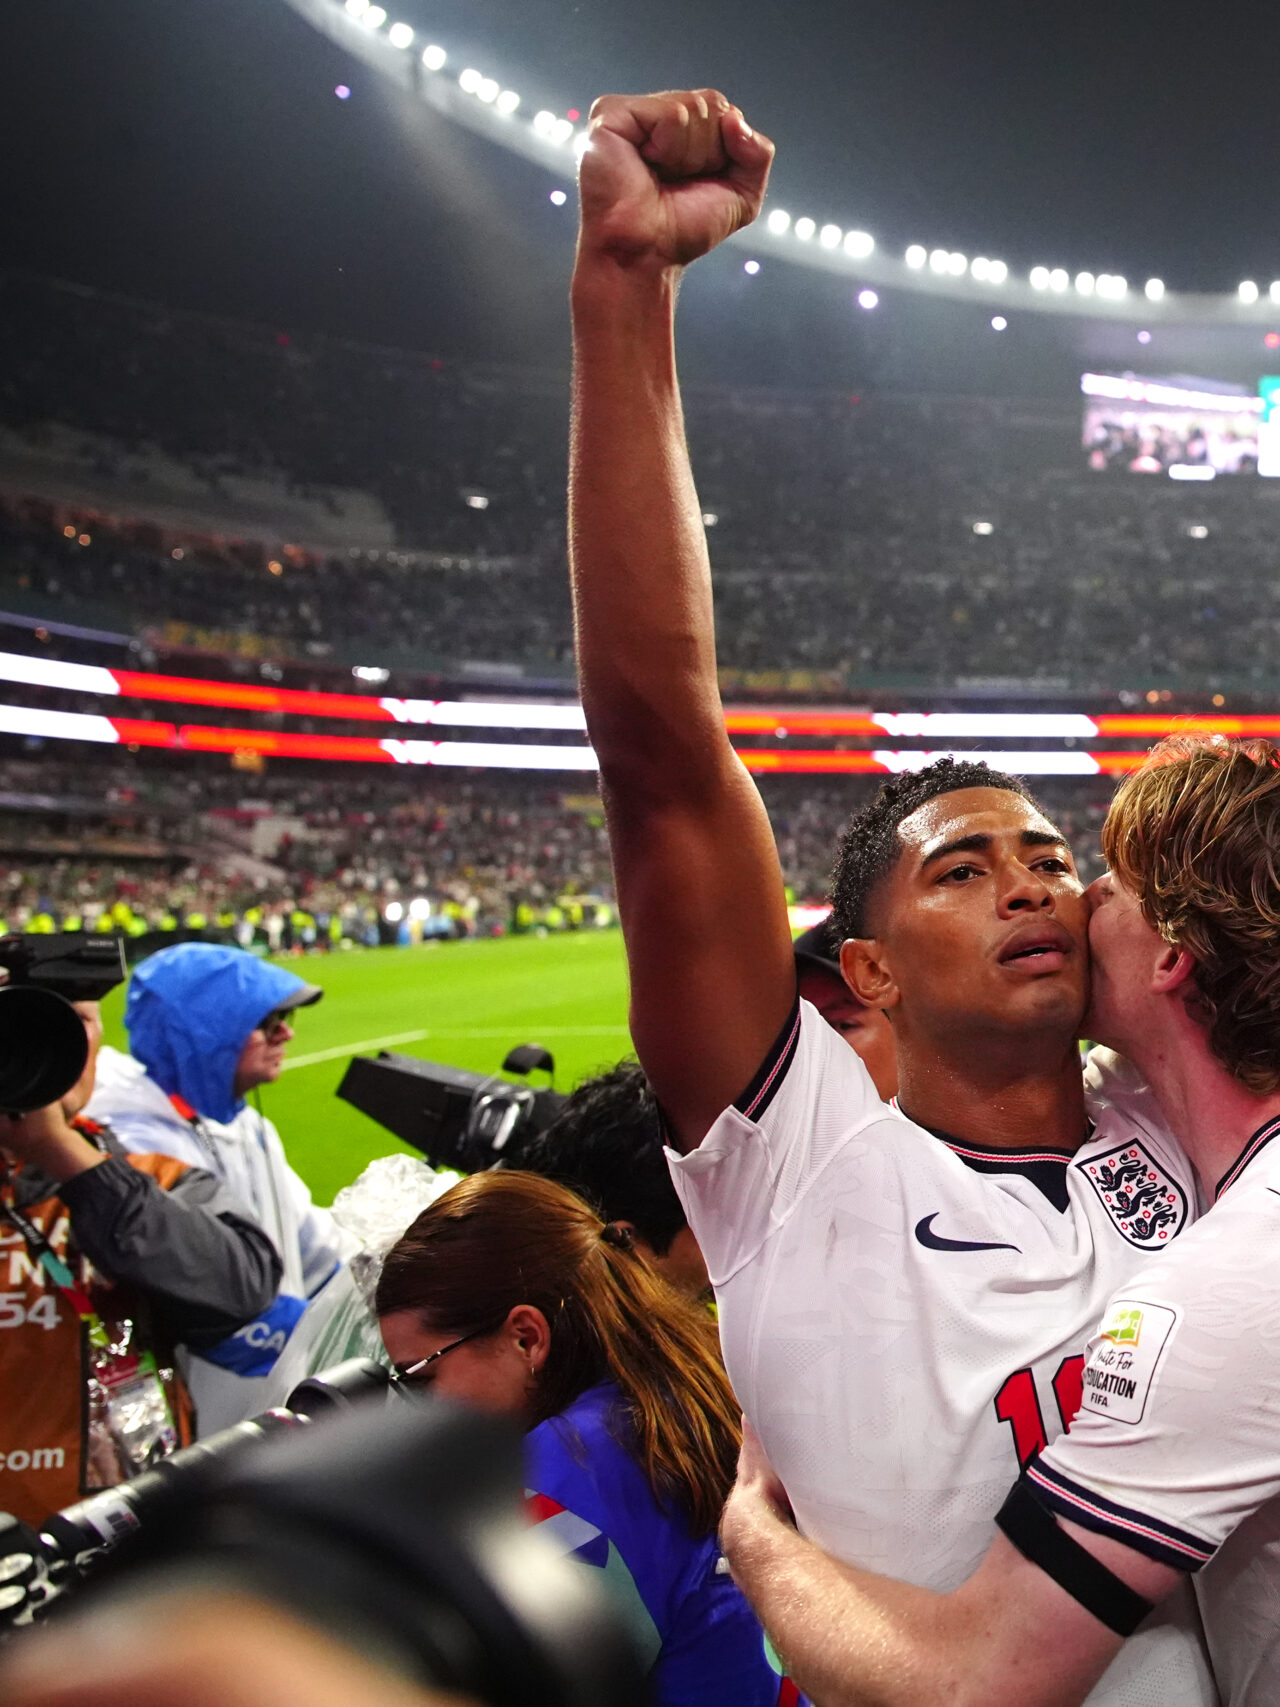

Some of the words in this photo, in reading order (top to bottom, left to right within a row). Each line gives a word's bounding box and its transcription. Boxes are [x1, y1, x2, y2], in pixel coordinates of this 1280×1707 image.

[1115, 1351, 1134, 1370] For
[1090, 1392, 1109, 1407] FIFA
[993, 1353, 1085, 1470] 1
